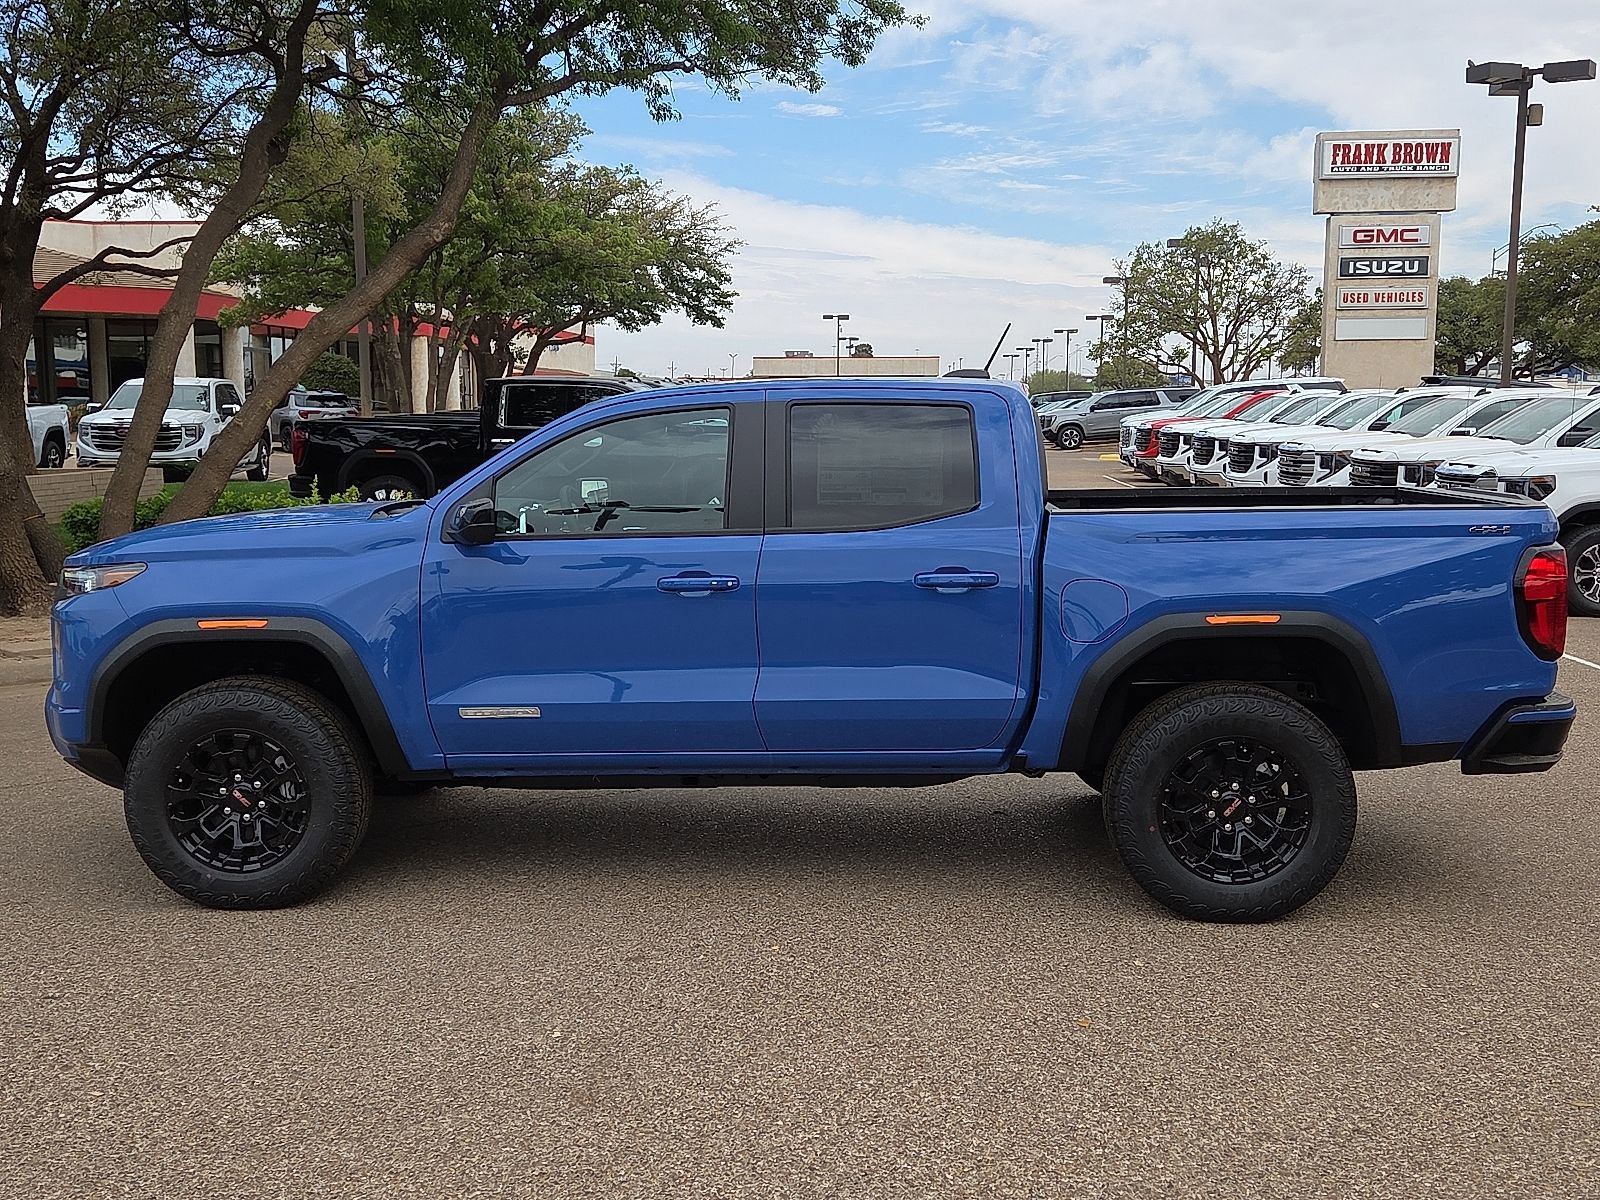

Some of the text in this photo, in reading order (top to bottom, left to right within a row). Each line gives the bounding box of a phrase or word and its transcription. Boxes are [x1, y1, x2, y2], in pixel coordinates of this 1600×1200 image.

[1331, 142, 1452, 165] FRANK BROWN
[1353, 228, 1420, 243] GMC
[1349, 260, 1420, 274] ISUZU
[1342, 291, 1424, 304] USED VEHICLES
